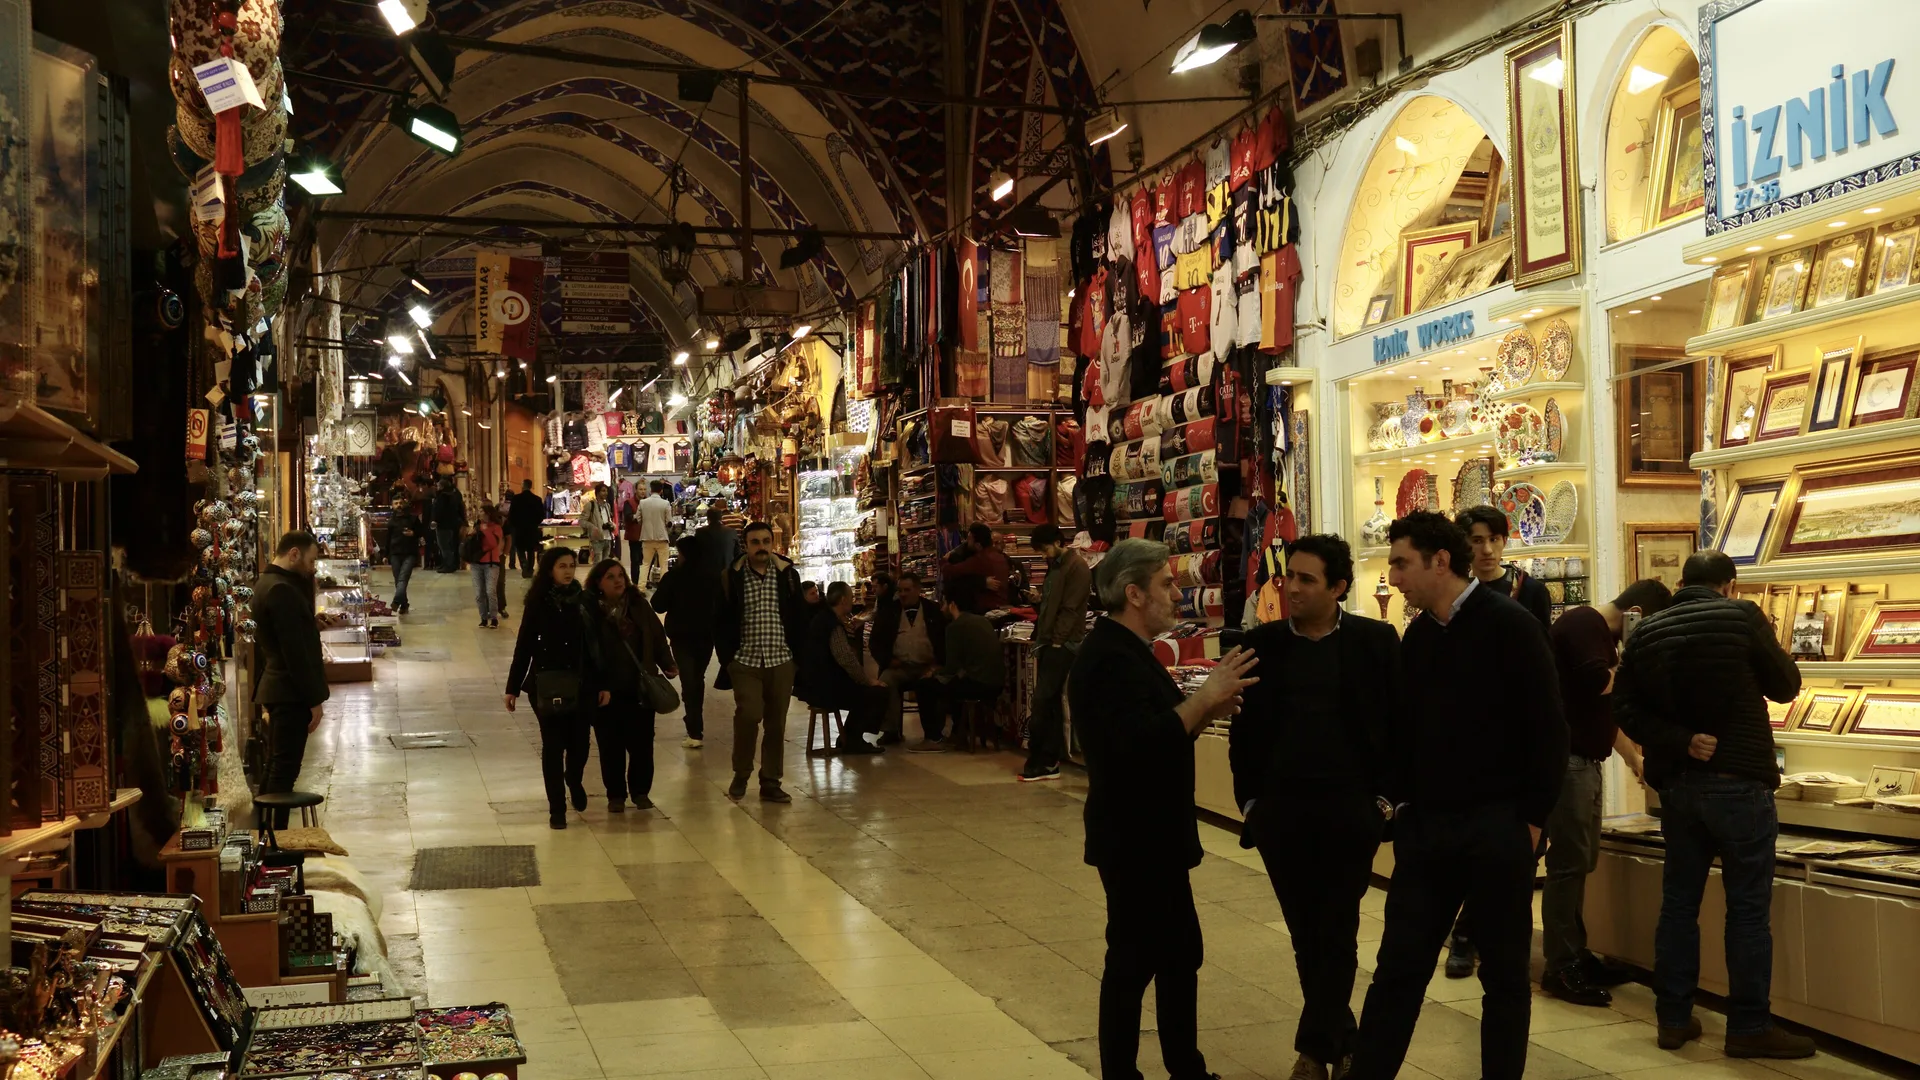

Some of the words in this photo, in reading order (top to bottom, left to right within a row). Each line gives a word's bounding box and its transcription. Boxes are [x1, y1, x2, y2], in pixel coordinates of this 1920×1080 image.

[1731, 58, 1899, 187] İZNİK
[1373, 328, 1409, 364] İZNİK
[1417, 310, 1475, 350] WORKS
[251, 990, 276, 1000] GIFT
[277, 990, 307, 999] SHOP
